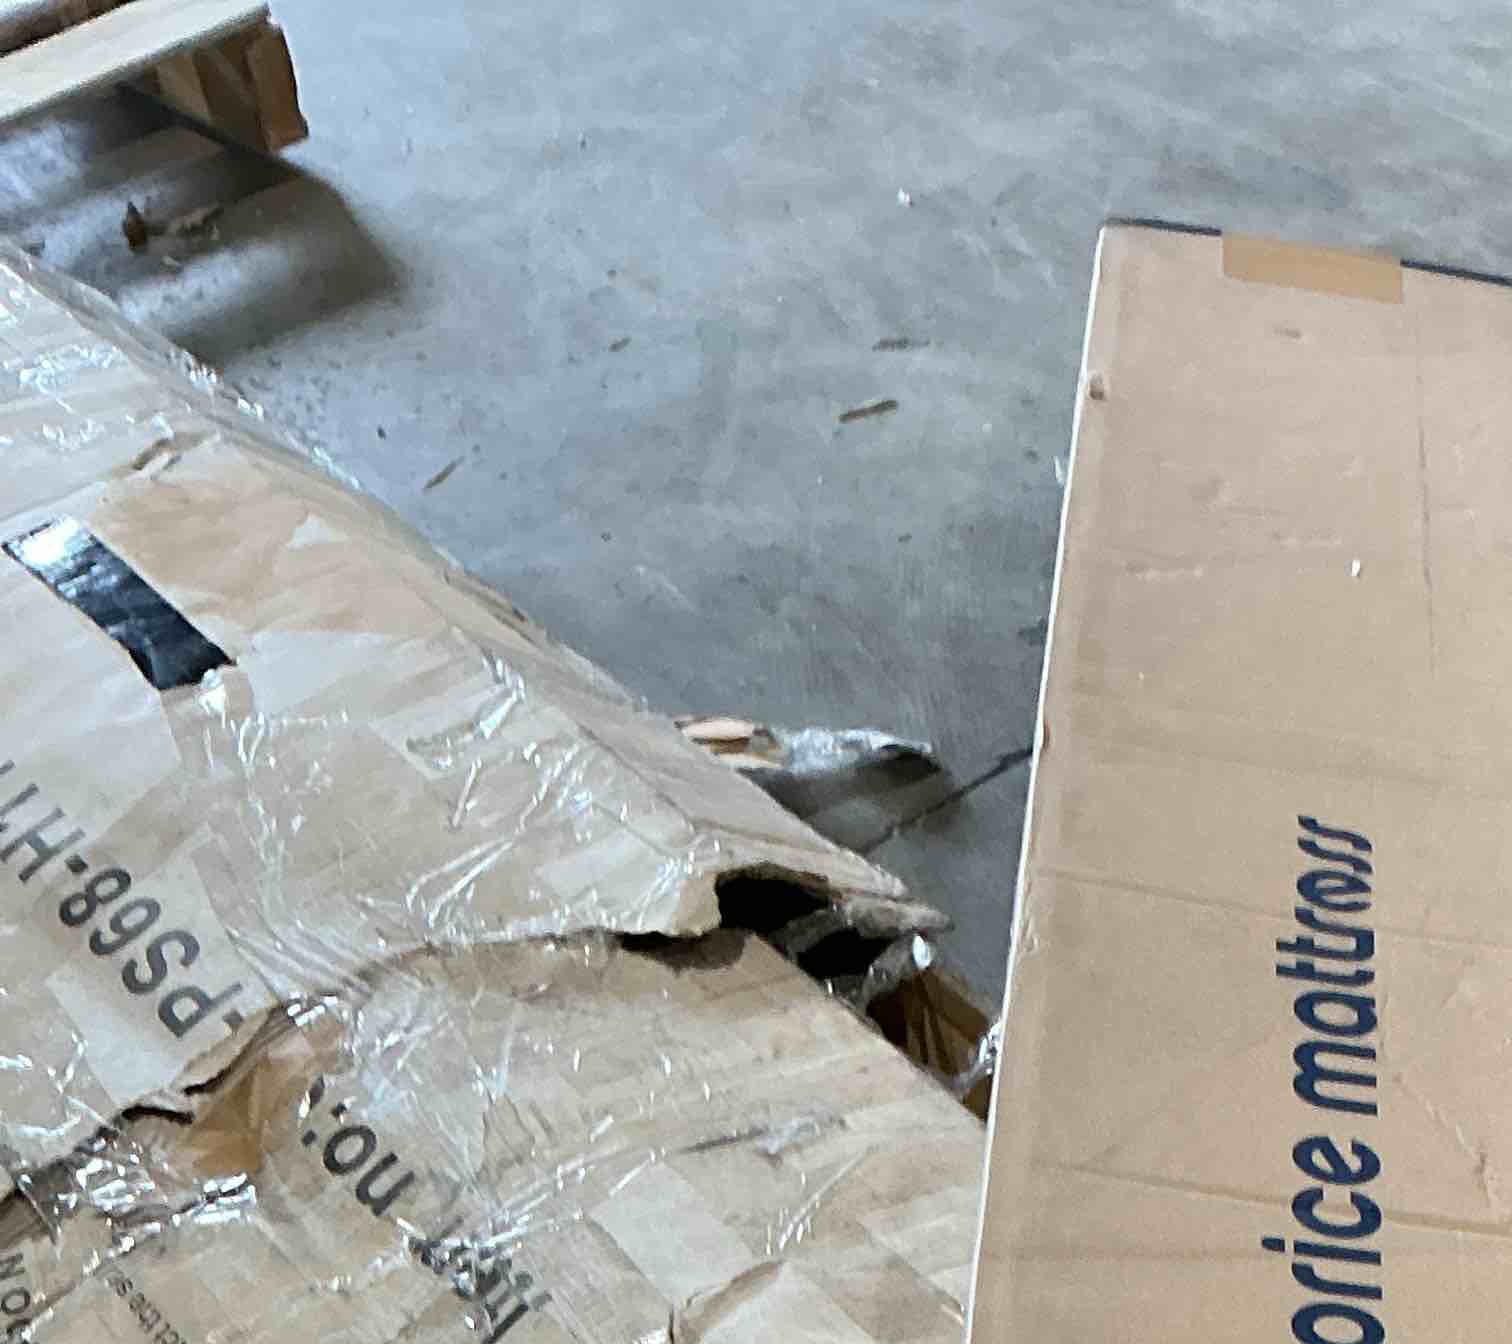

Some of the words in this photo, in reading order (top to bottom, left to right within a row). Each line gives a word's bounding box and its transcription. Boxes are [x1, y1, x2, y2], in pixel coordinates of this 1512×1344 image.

[0, 760, 244, 1038] -PS68-H1
[1275, 814, 1383, 1117] mattress
[301, 1100, 416, 1218] no:
